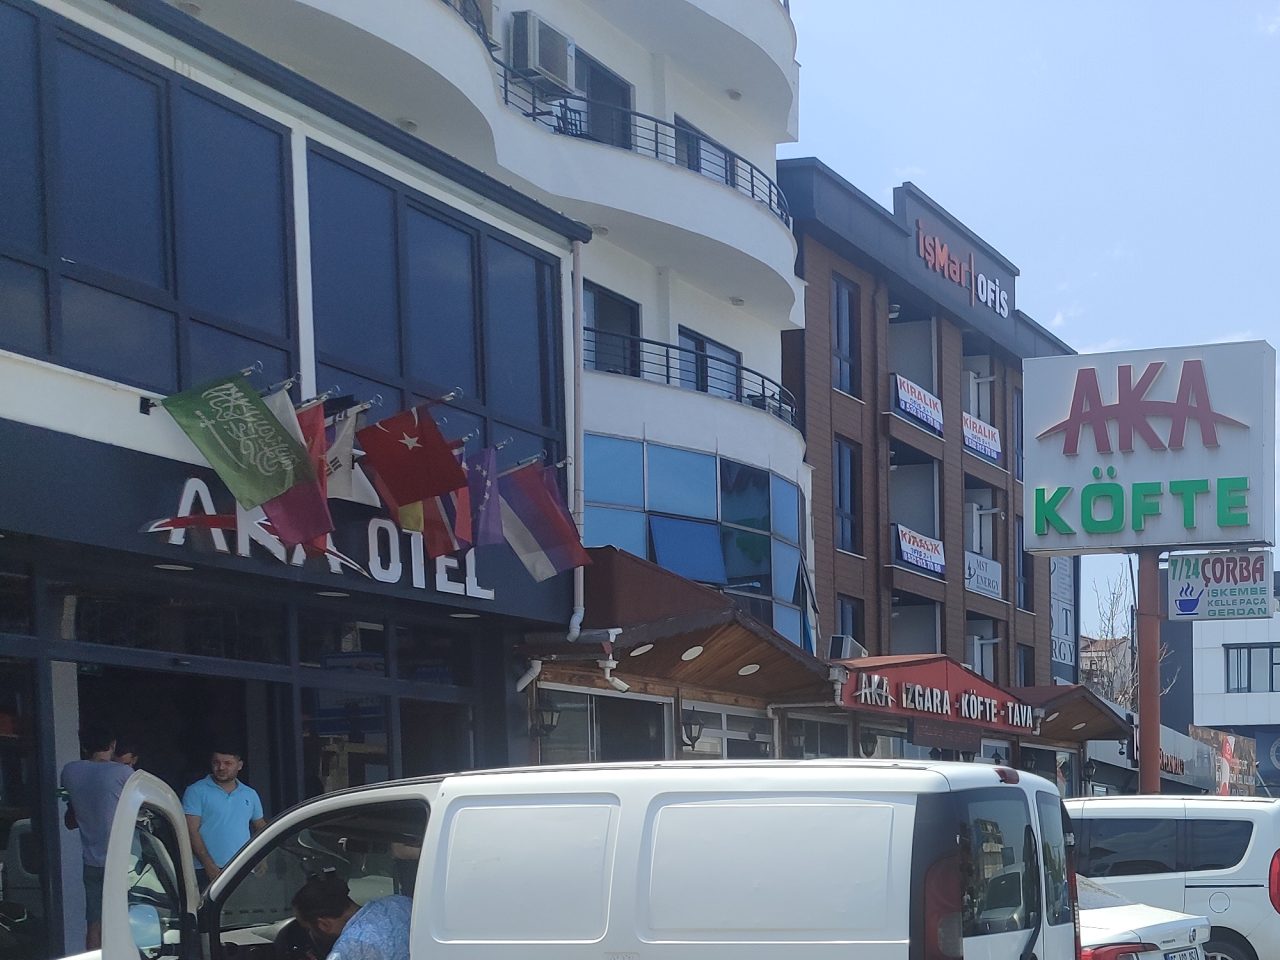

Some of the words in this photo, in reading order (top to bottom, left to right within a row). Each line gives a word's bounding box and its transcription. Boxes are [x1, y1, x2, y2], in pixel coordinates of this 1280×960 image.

[977, 273, 1008, 318] OFİS
[899, 378, 940, 413] KİRALIK
[1042, 359, 1245, 455] AKA
[963, 415, 998, 441] KİRALIK
[1034, 465, 1249, 536] KÖFTE
[368, 517, 495, 600] OTEL
[1170, 557, 1200, 581] 7/24
[1201, 555, 1265, 587] ÇORBA
[976, 575, 999, 592] ENERGY
[1208, 599, 1238, 607] KELLE
[1239, 597, 1267, 606] PAÇA
[1208, 607, 1267, 617] GERDAN
[854, 673, 896, 707] AKA
[961, 689, 997, 723] KÖFTE
[1007, 702, 1033, 728] TAVA
